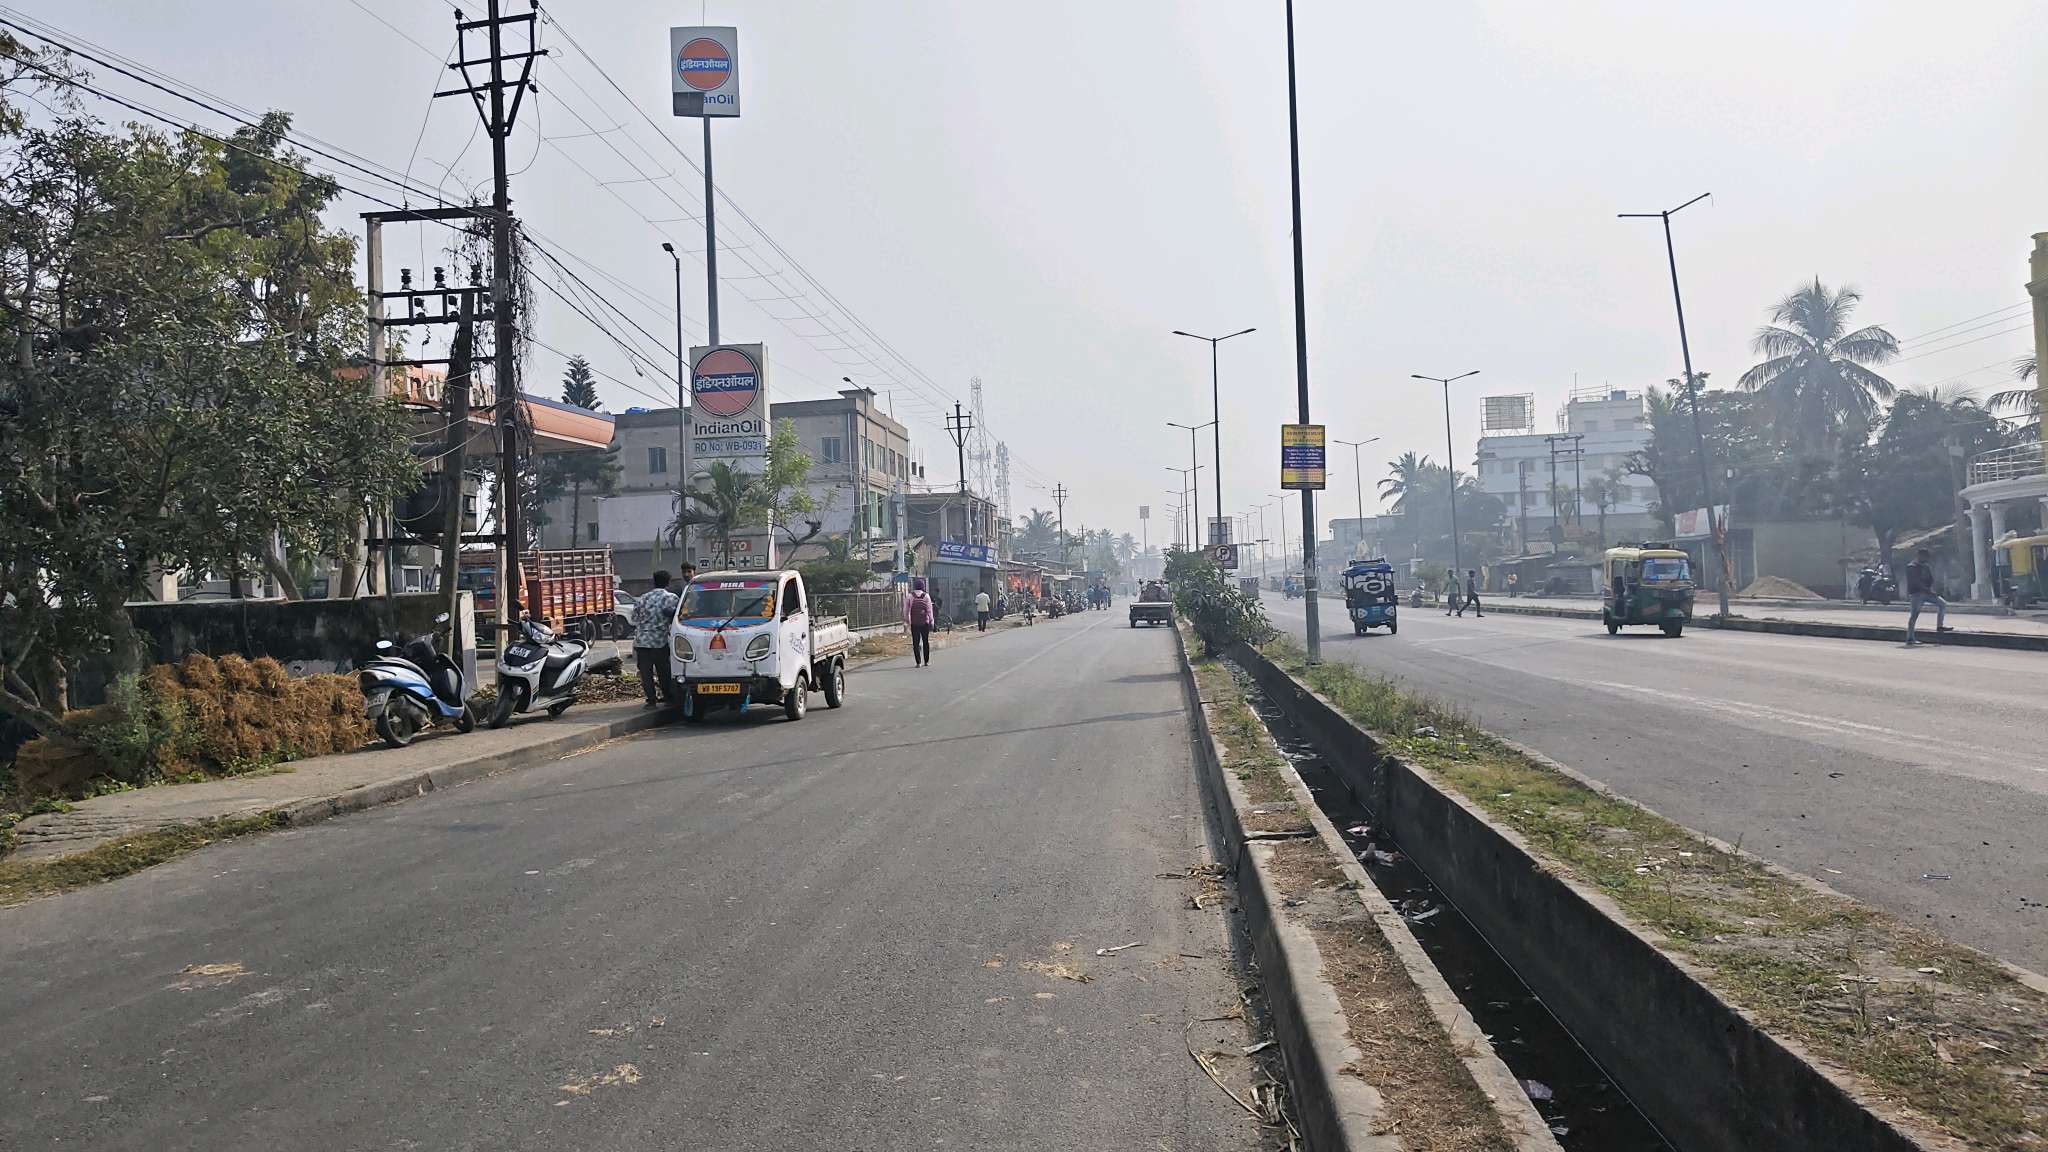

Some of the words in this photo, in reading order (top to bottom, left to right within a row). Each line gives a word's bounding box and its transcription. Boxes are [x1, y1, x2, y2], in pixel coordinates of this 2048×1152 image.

[694, 420, 762, 435] IndianOil
[695, 442, 707, 453] RO
[725, 440, 762, 451] WB-0931
[940, 543, 966, 552] KEI
